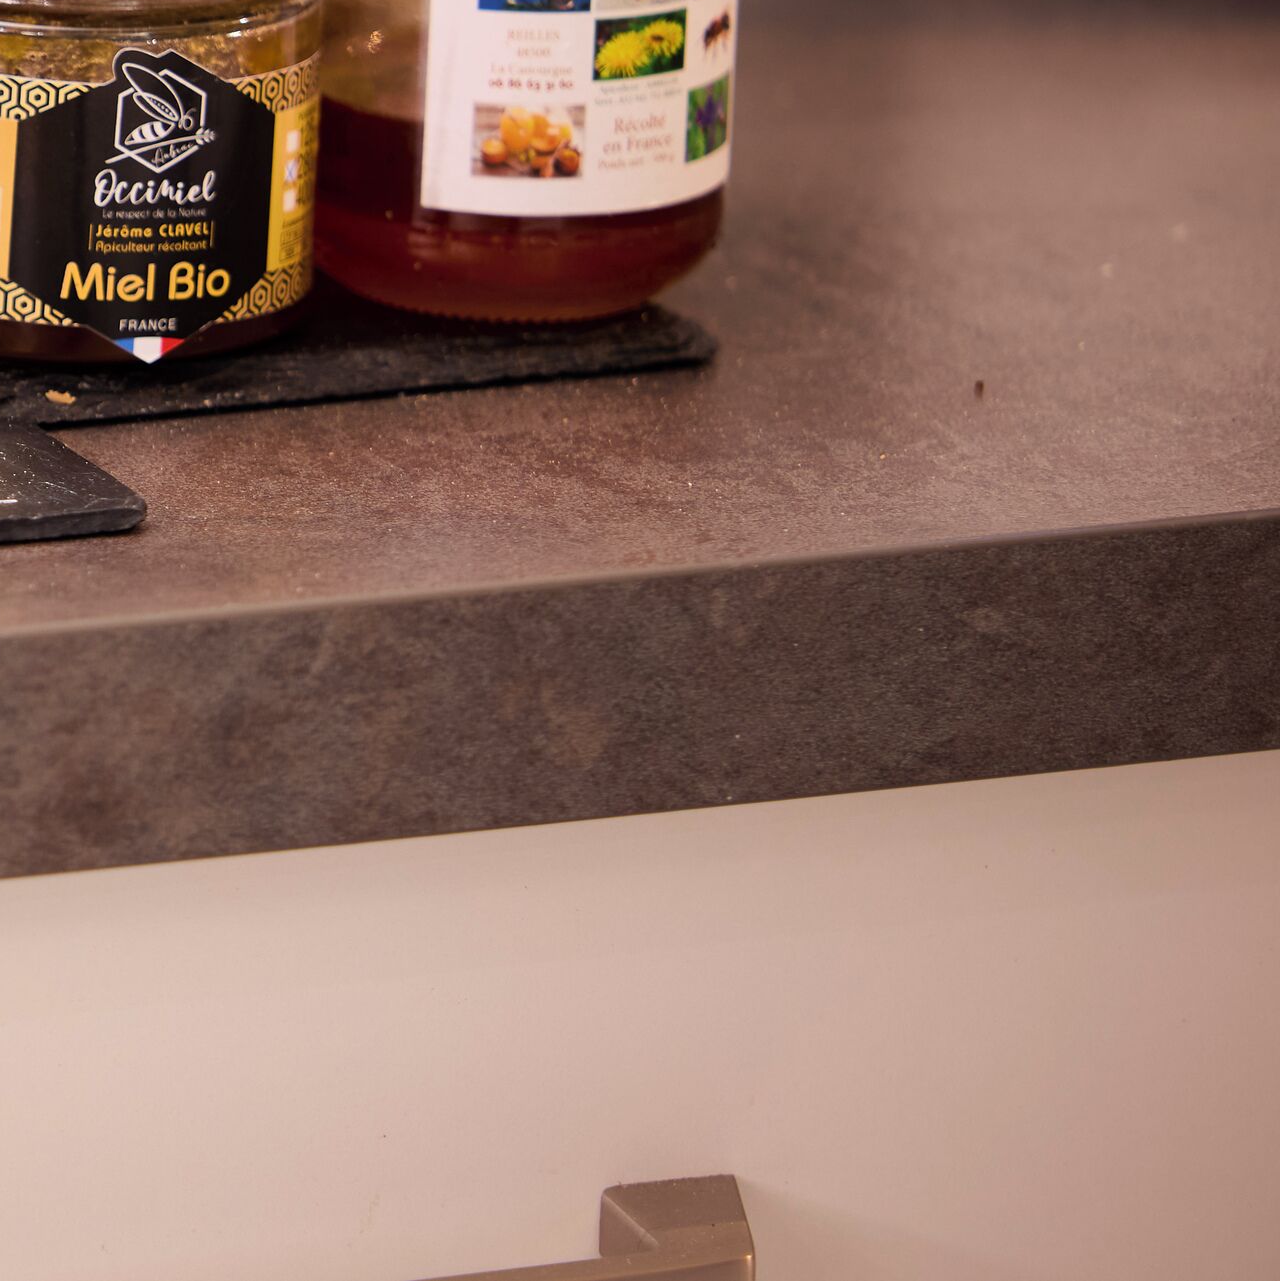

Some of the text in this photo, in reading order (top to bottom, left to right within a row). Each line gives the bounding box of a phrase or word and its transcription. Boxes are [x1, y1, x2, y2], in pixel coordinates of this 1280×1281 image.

[94, 168, 216, 207] Occimiel
[102, 207, 206, 220] Le respect de la Nature
[96, 221, 209, 237] Jérôme CLAVEL
[96, 239, 207, 254] Apiculteur récoltant
[60, 261, 230, 301] Miel Bio
[119, 318, 176, 332] FRANCE
